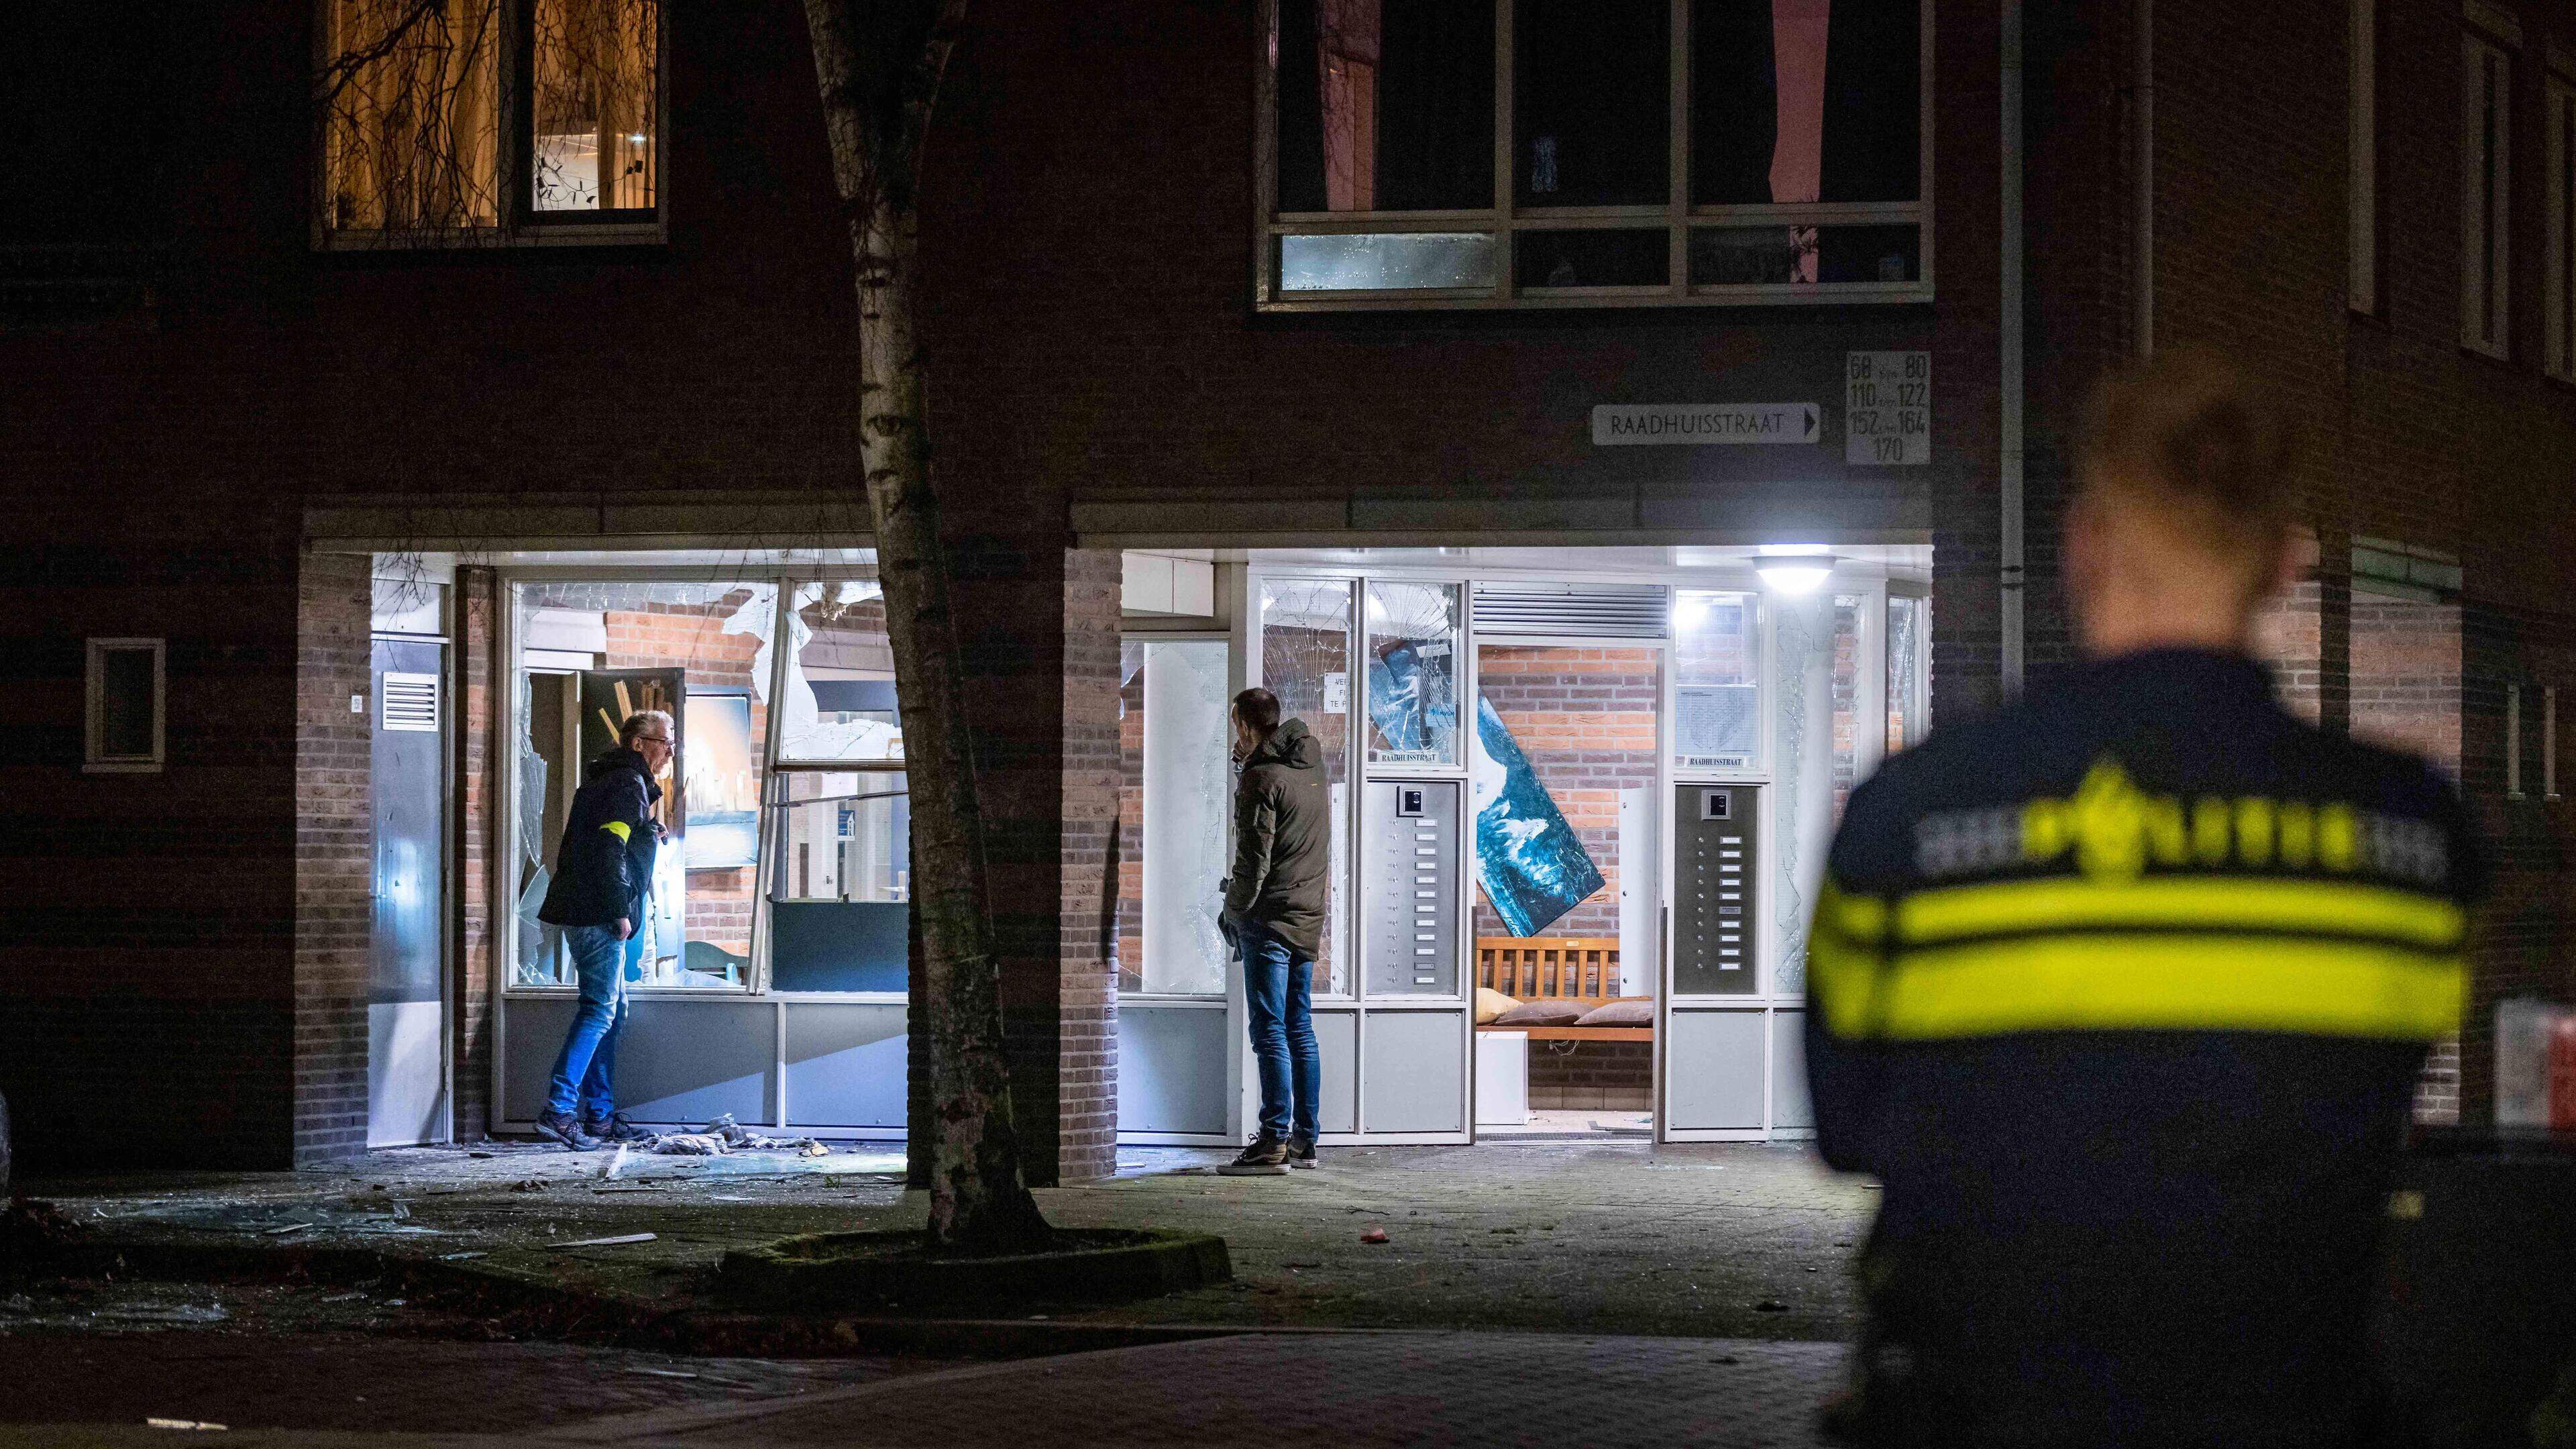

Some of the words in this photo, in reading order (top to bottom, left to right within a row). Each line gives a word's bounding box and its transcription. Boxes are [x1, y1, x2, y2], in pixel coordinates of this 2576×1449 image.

[1851, 356, 1872, 379] 68
[1905, 356, 1926, 378] 80
[1850, 382, 1876, 407] 110
[1897, 383, 1926, 407] 122
[1611, 413, 1784, 435] RAADHUISSTRAAT
[1849, 411, 1878, 435] 152
[1897, 411, 1926, 434] 164
[1874, 437, 1902, 461] 170
[1381, 754, 1436, 763] RAADHUISSTRAAT
[1690, 758, 1742, 766] RAADHUISSTRAAT
